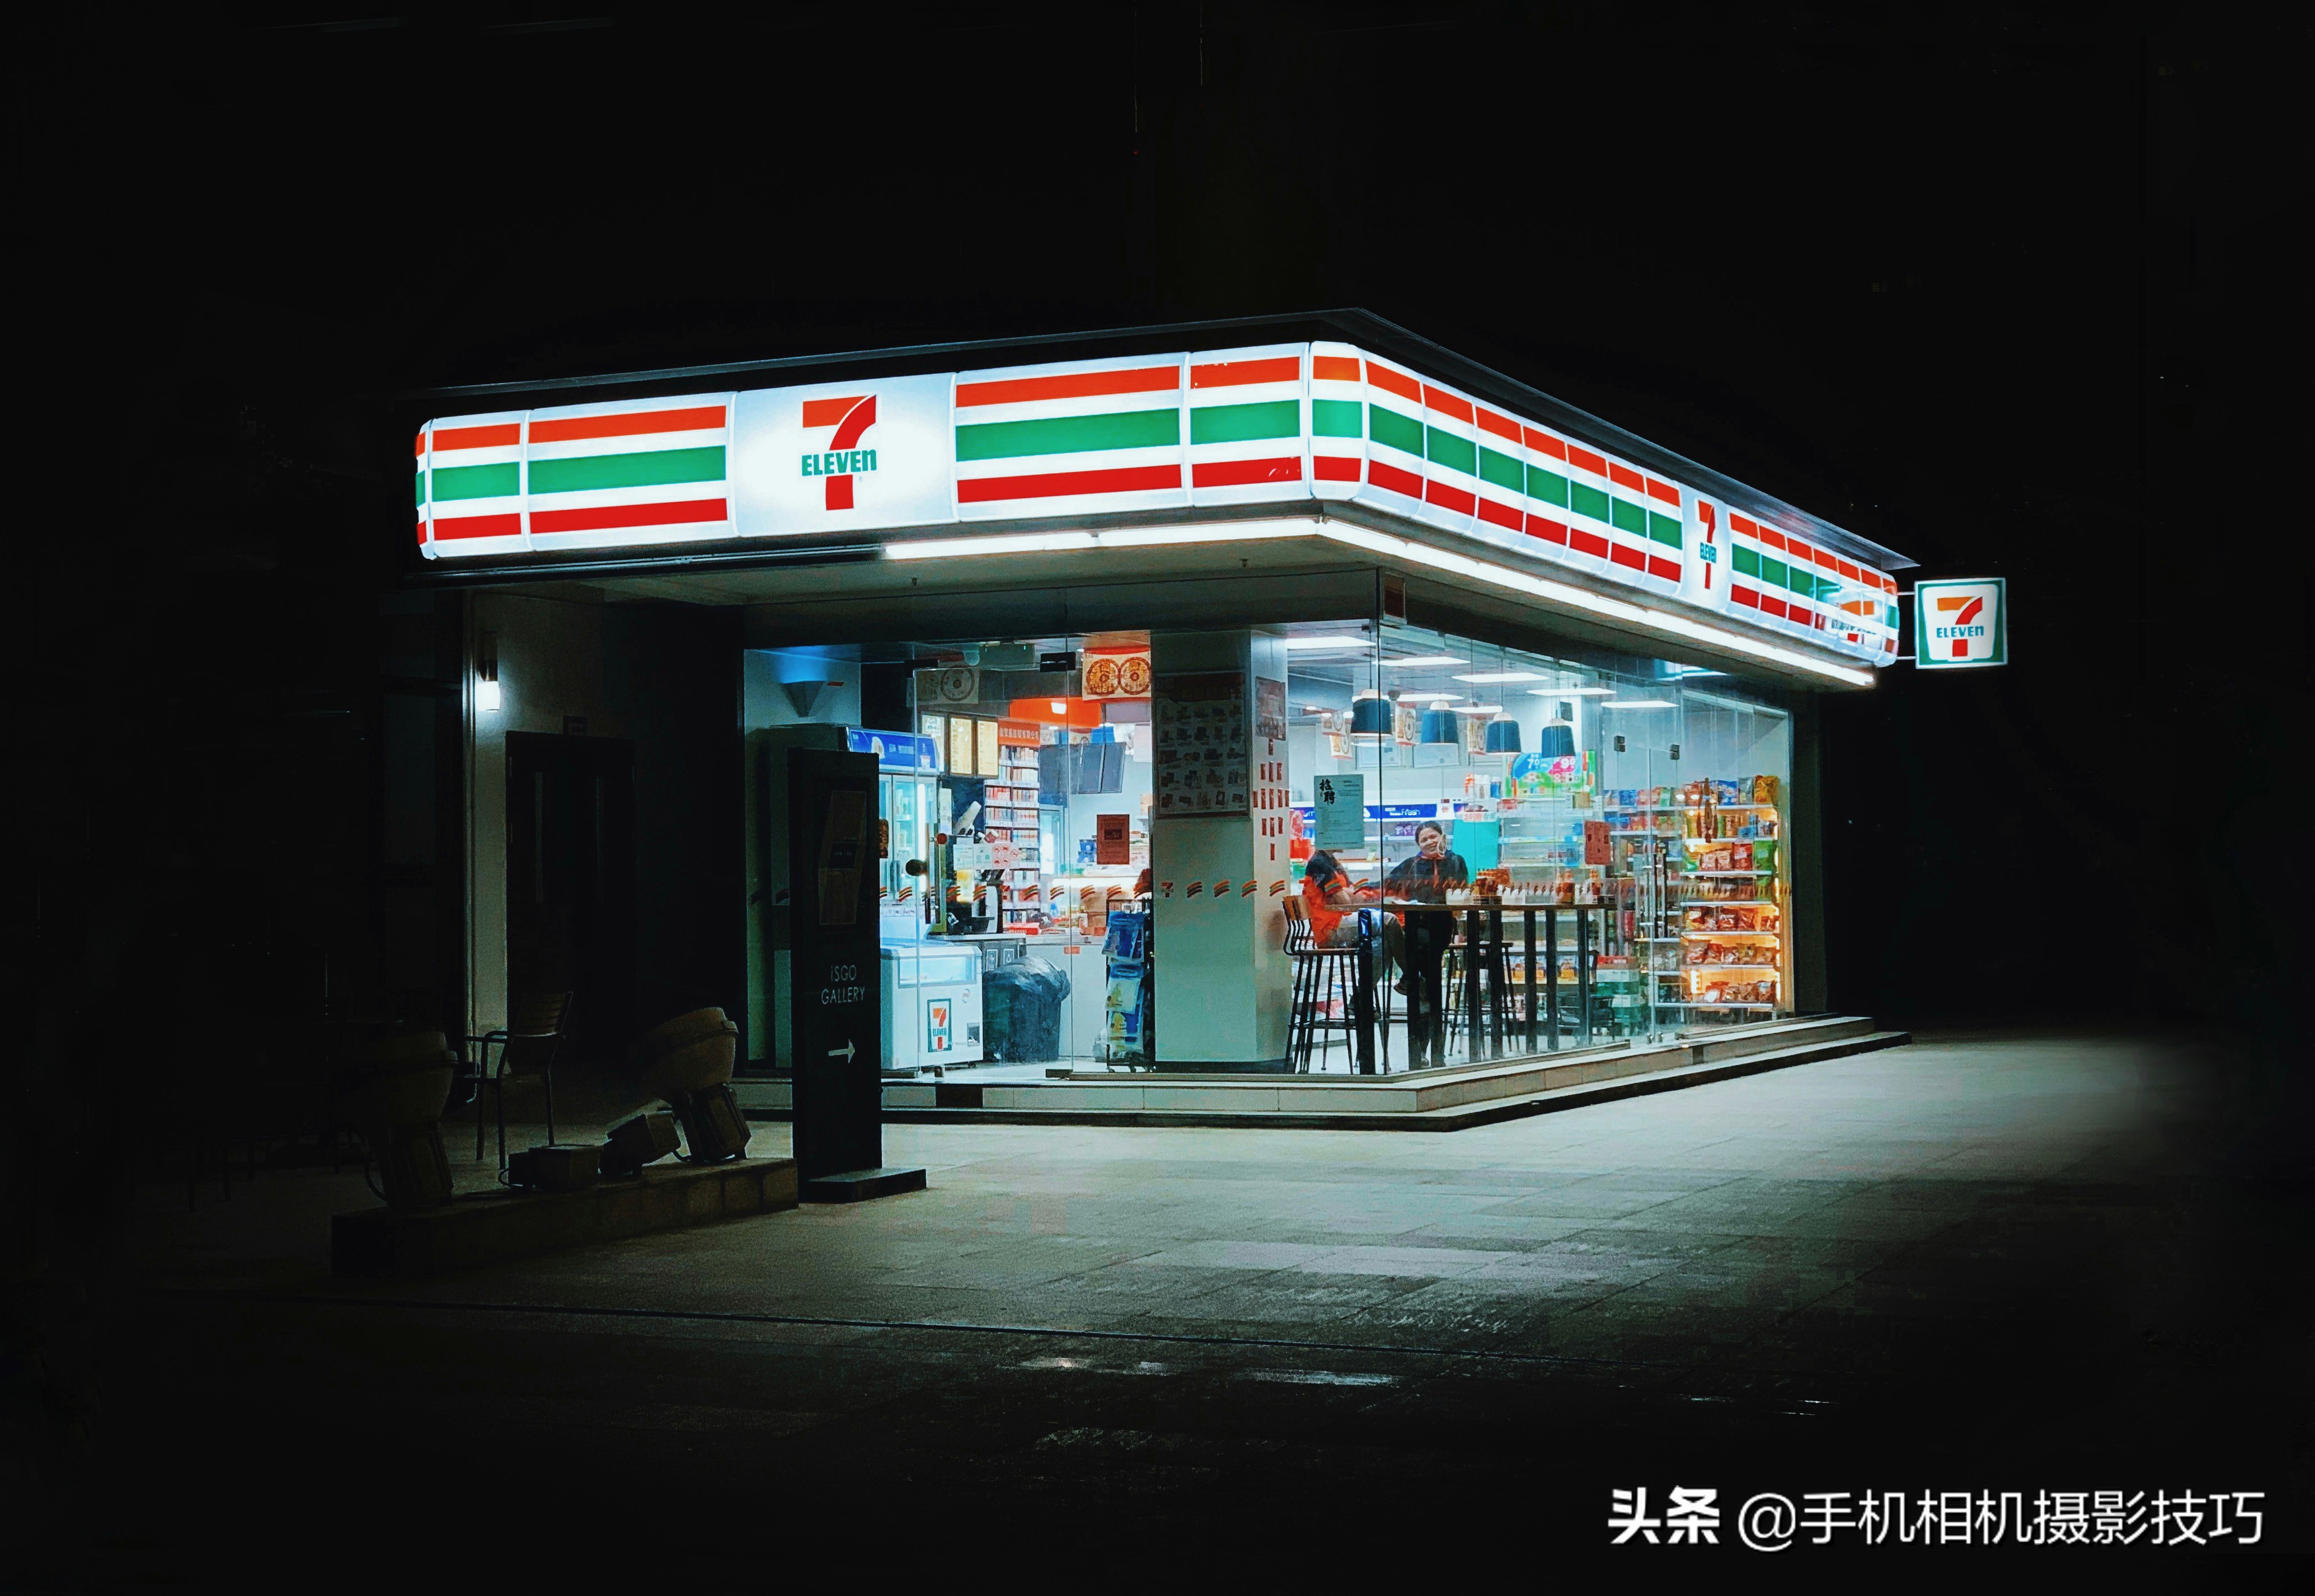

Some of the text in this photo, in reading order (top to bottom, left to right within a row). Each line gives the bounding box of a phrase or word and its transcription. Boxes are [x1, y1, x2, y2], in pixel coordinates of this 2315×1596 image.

[801, 394, 877, 511] 7 ELEVEn
[1698, 500, 1716, 590] 7
[1937, 596, 1983, 657] 7
[821, 986, 865, 1005] GALLERY
[933, 1007, 947, 1049] 7
